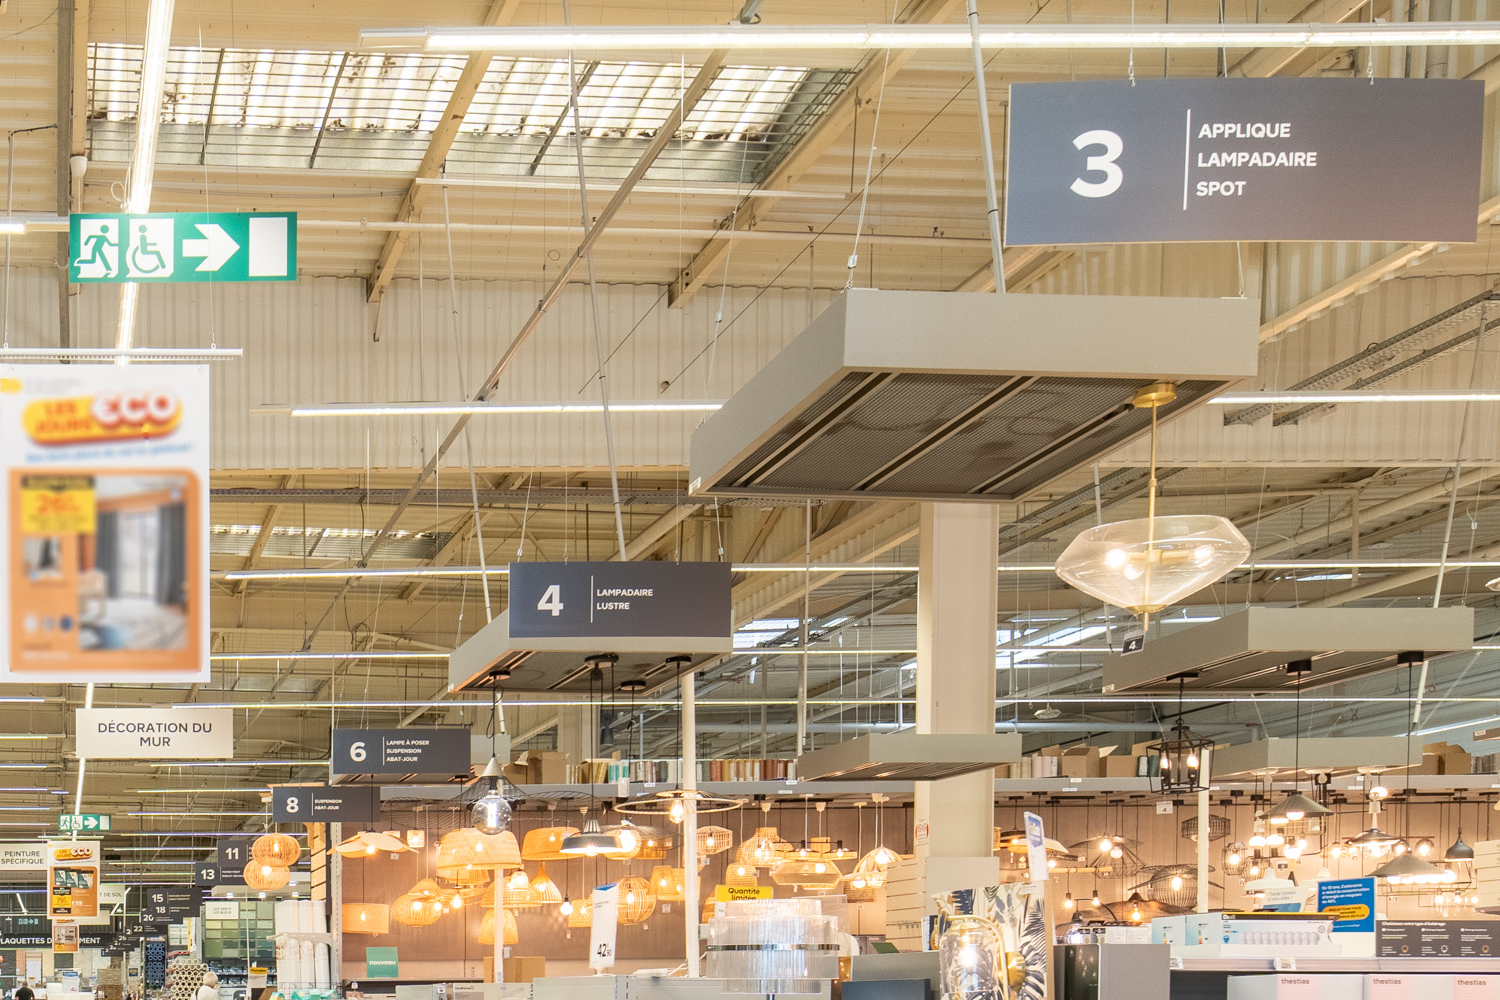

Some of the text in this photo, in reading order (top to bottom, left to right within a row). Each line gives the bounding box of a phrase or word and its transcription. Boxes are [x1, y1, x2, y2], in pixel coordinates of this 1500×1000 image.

[1198, 122, 1291, 140] APPLIQUE
[1070, 129, 1124, 199] 3
[1197, 151, 1317, 168] LAMPADAIRE
[1196, 181, 1246, 197] SPOT
[596, 588, 654, 597] LAMPADAIRE
[537, 584, 564, 616] 4
[596, 602, 630, 610] LUSTRE
[98, 720, 212, 733] DÉCORATION DU
[140, 737, 171, 747] MUR
[350, 741, 367, 762] 6
[286, 797, 299, 813] 8
[225, 847, 239, 860] 11
[201, 869, 215, 880] 13
[151, 894, 164, 902] 15
[728, 887, 760, 896] Quantité
[155, 906, 166, 914] 18
